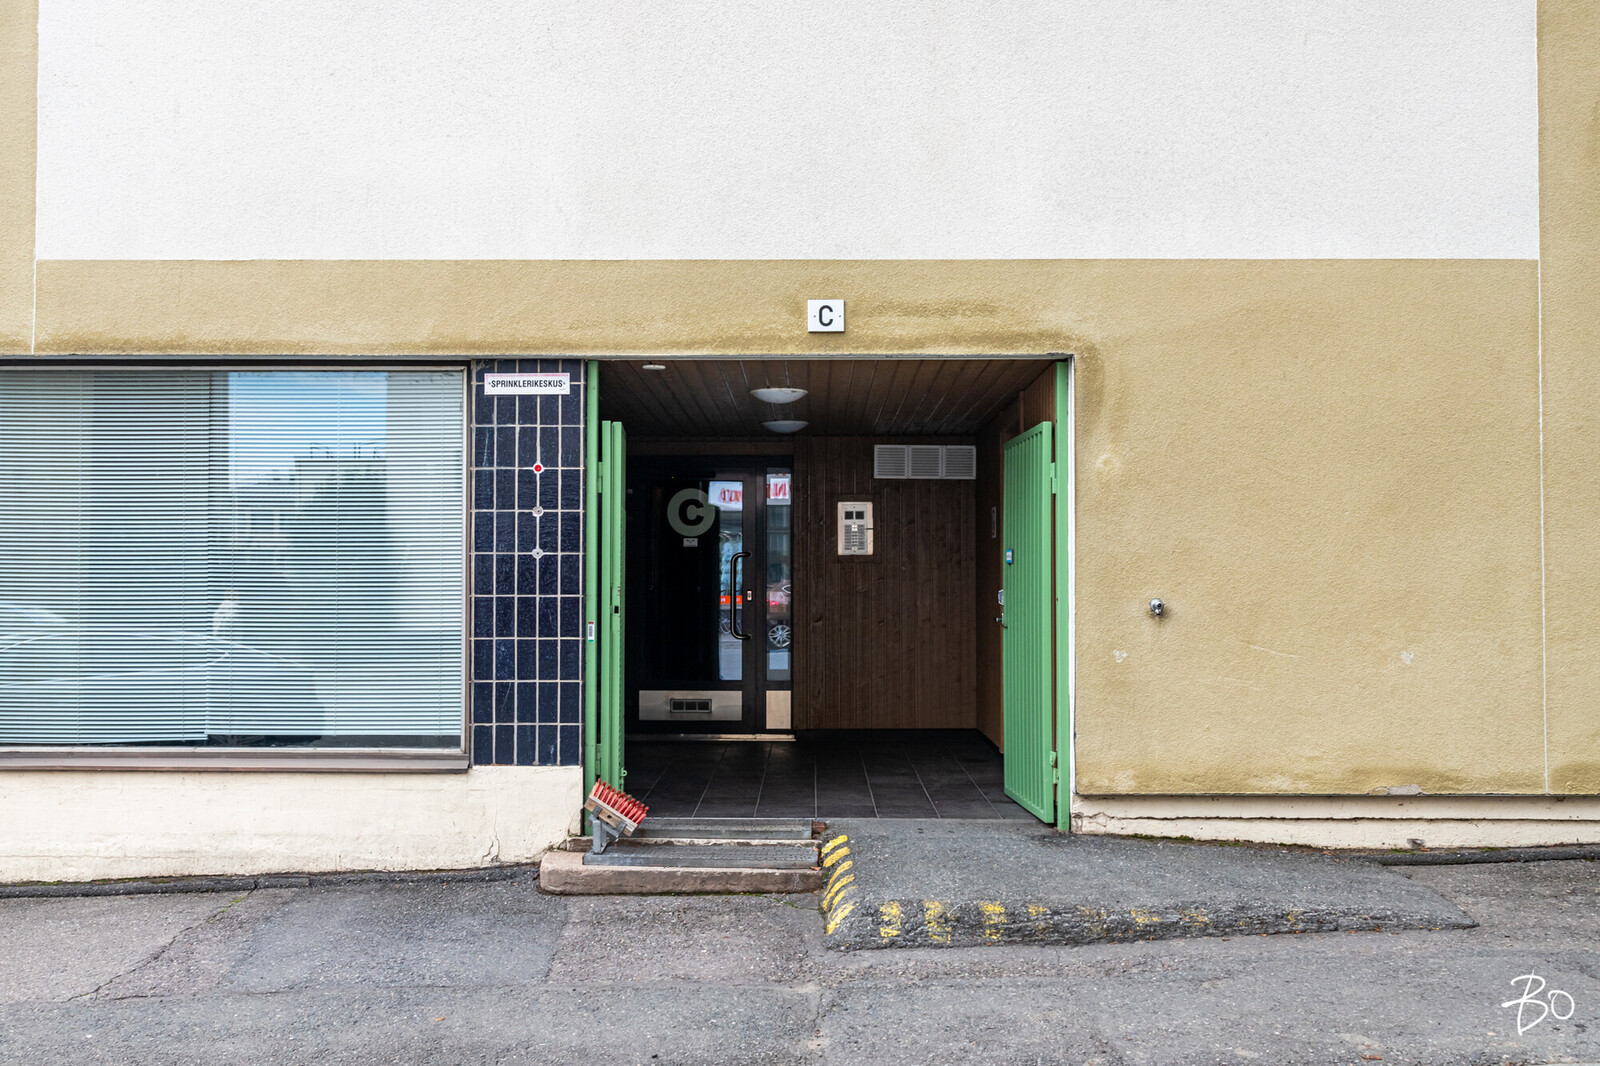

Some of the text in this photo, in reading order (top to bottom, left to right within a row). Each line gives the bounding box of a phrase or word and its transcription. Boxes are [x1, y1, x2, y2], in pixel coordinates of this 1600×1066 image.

[818, 304, 834, 327] C
[491, 379, 563, 388] SPRINKLERIKESKUS
[678, 498, 704, 526] C
